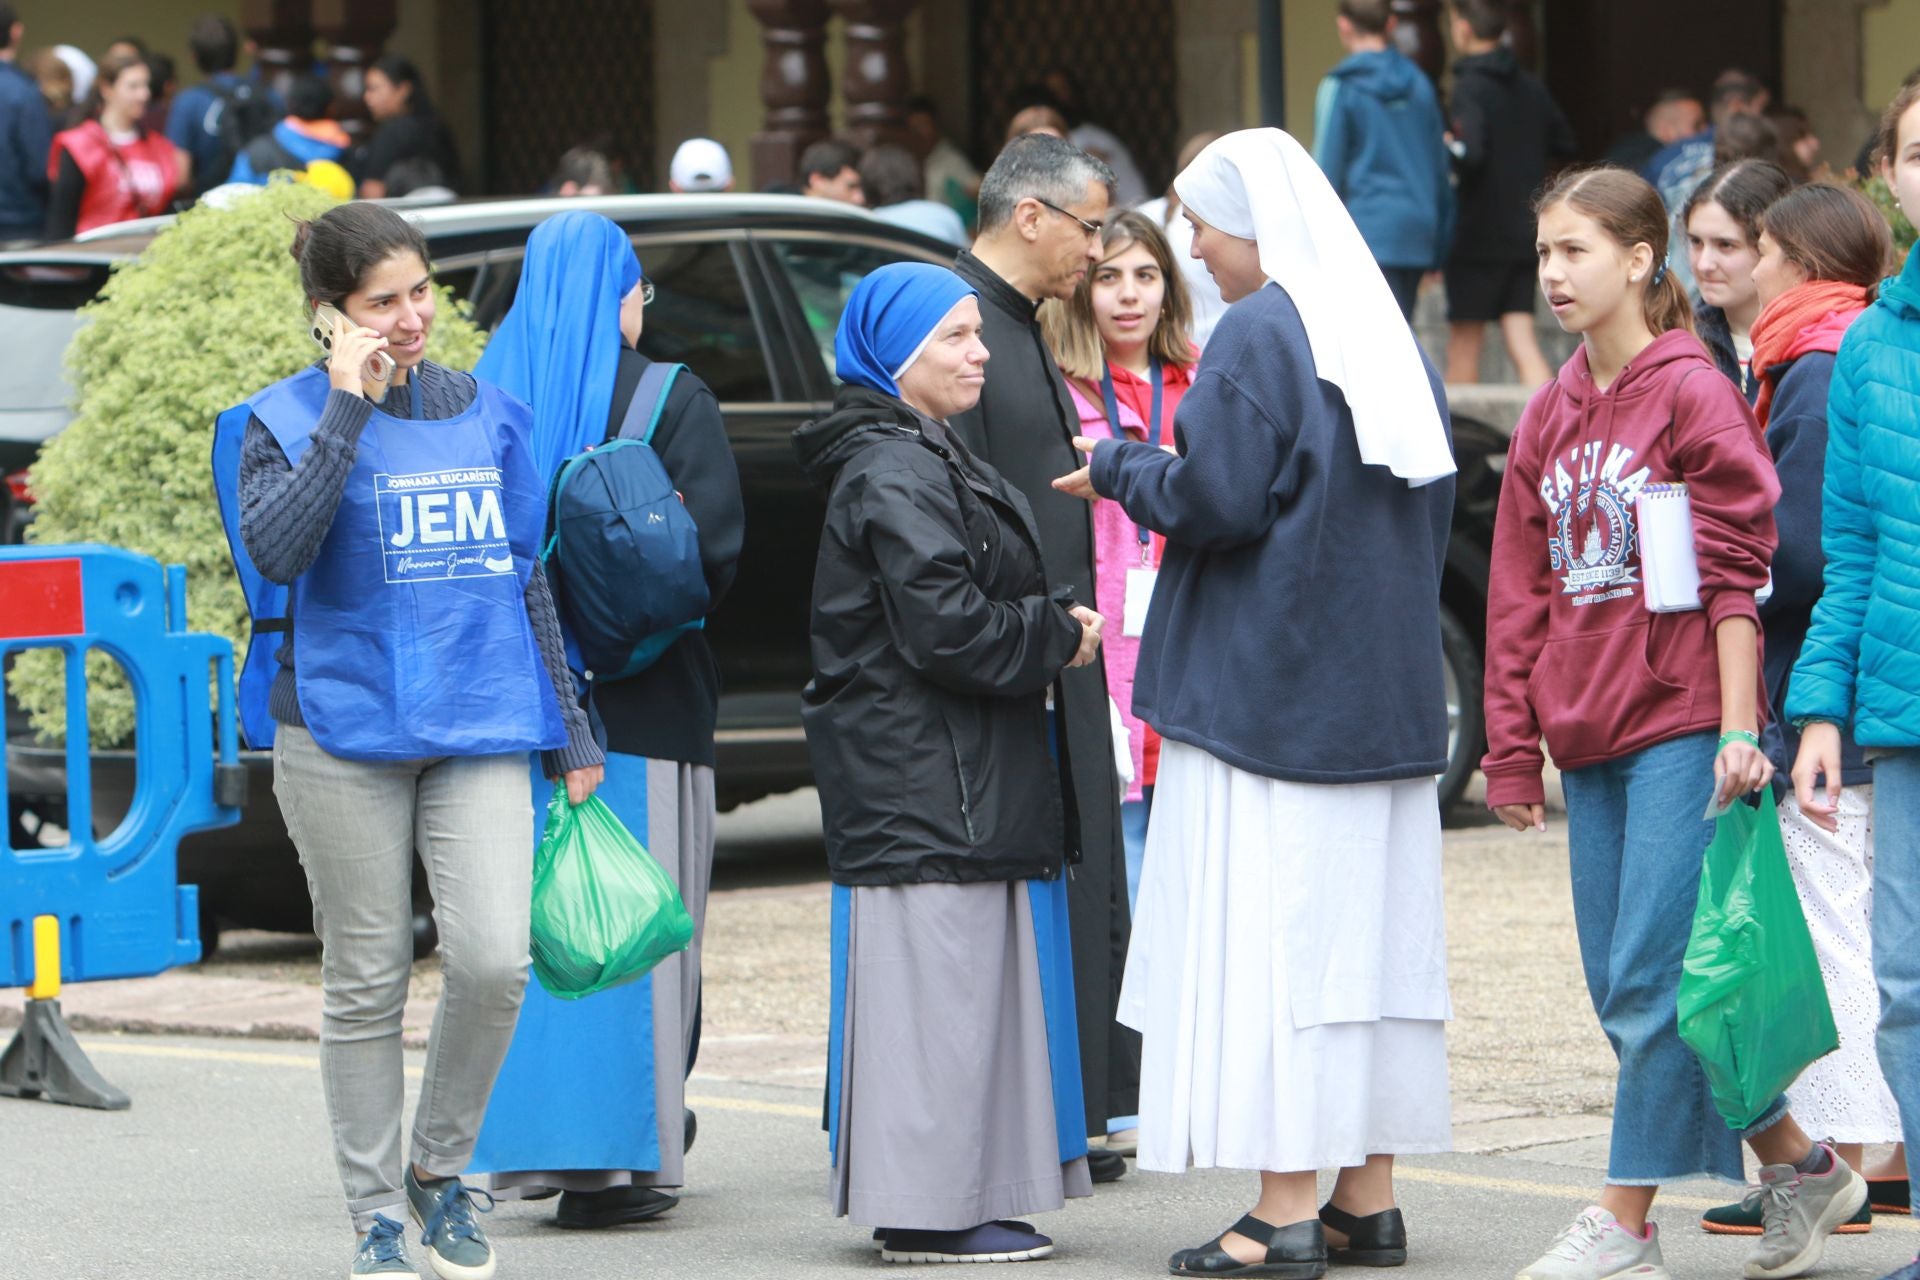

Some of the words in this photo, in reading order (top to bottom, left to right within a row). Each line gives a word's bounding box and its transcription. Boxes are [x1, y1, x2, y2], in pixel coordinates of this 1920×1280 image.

[388, 475, 439, 489] JORNADA
[390, 489, 506, 547] JEM
[397, 556, 446, 574] Mariana
[1601, 567, 1621, 578] 1139
